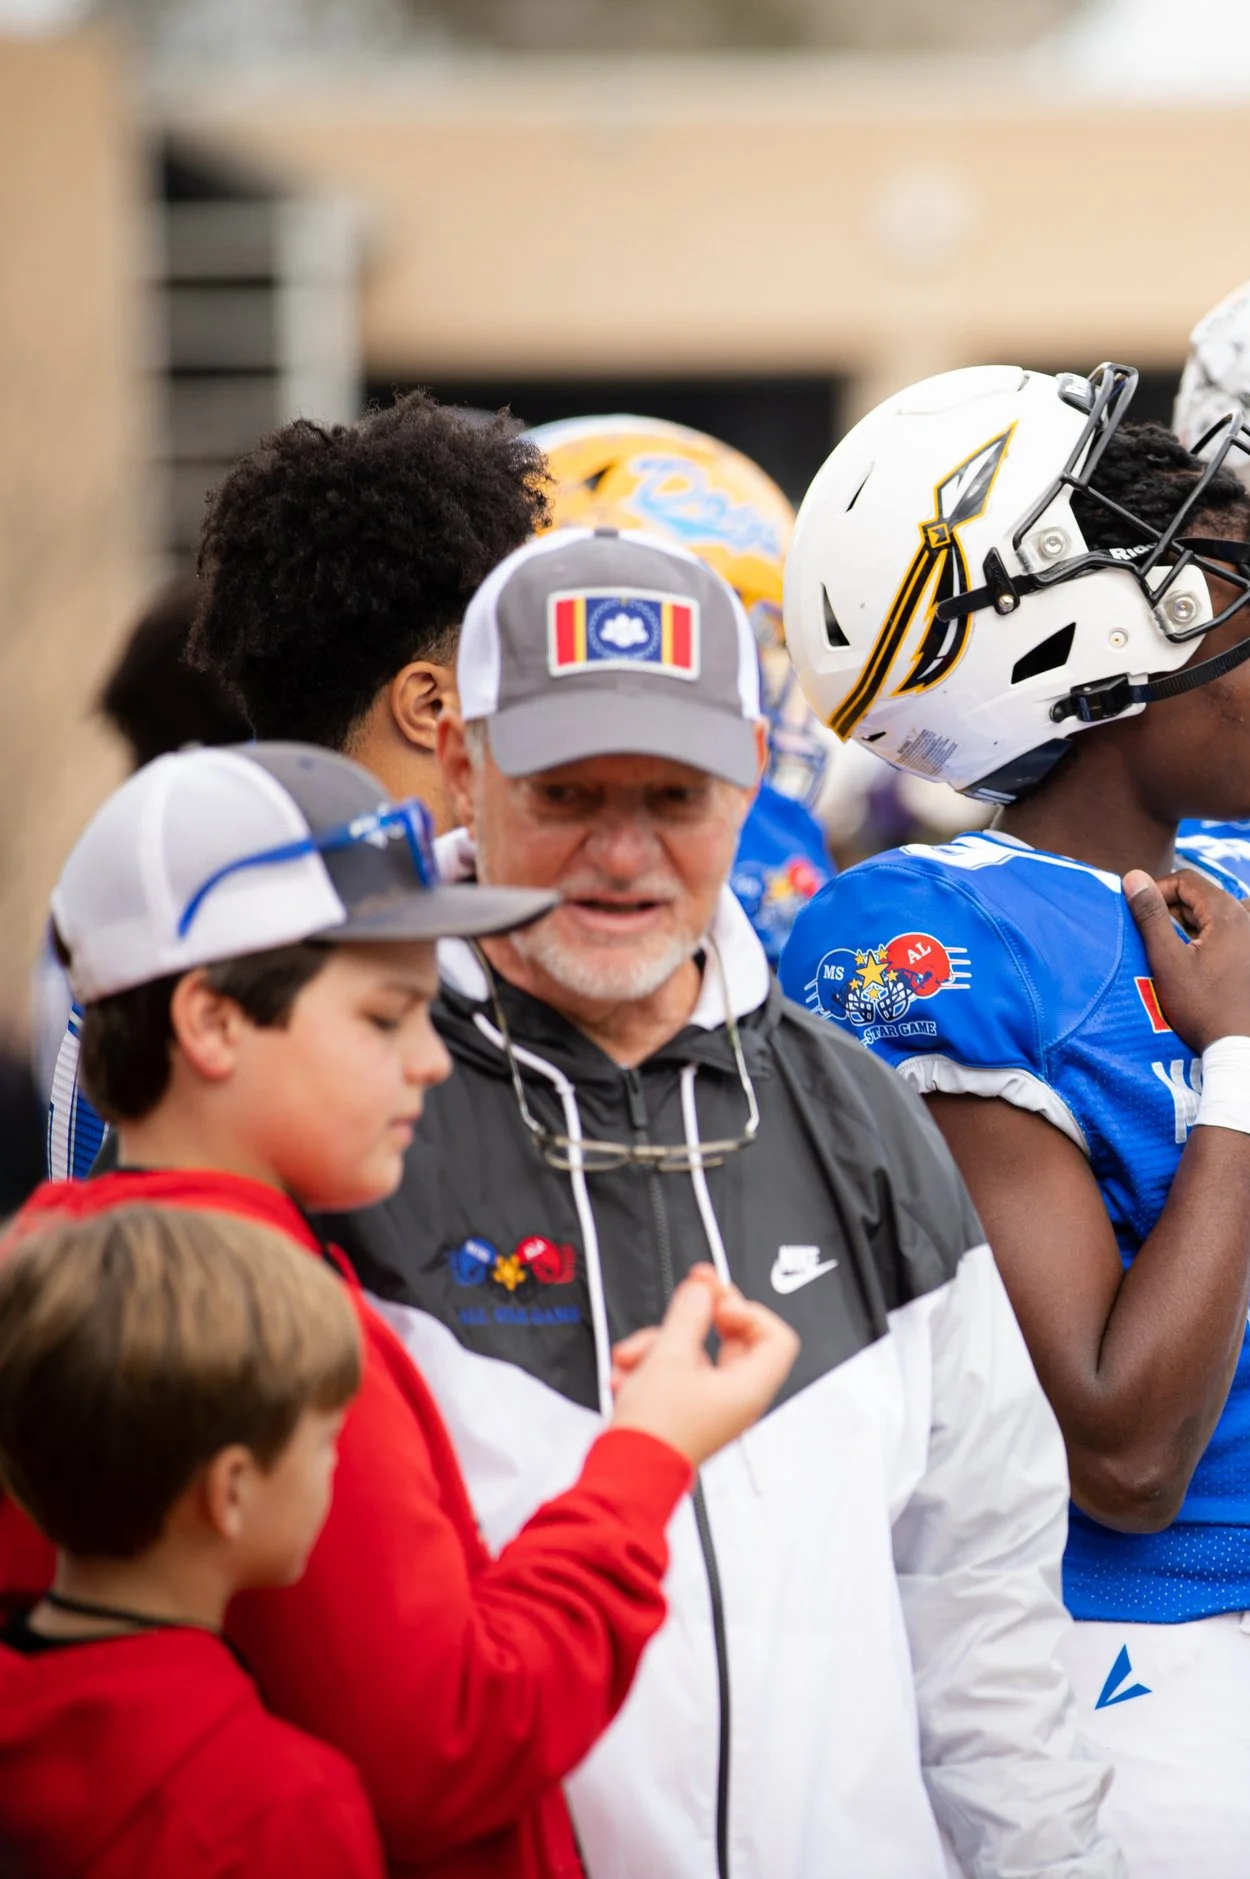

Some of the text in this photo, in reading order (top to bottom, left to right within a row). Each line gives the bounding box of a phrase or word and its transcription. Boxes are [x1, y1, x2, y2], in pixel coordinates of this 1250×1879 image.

[907, 942, 932, 965] AL
[823, 964, 845, 981] MS
[899, 1021, 937, 1037] GAME
